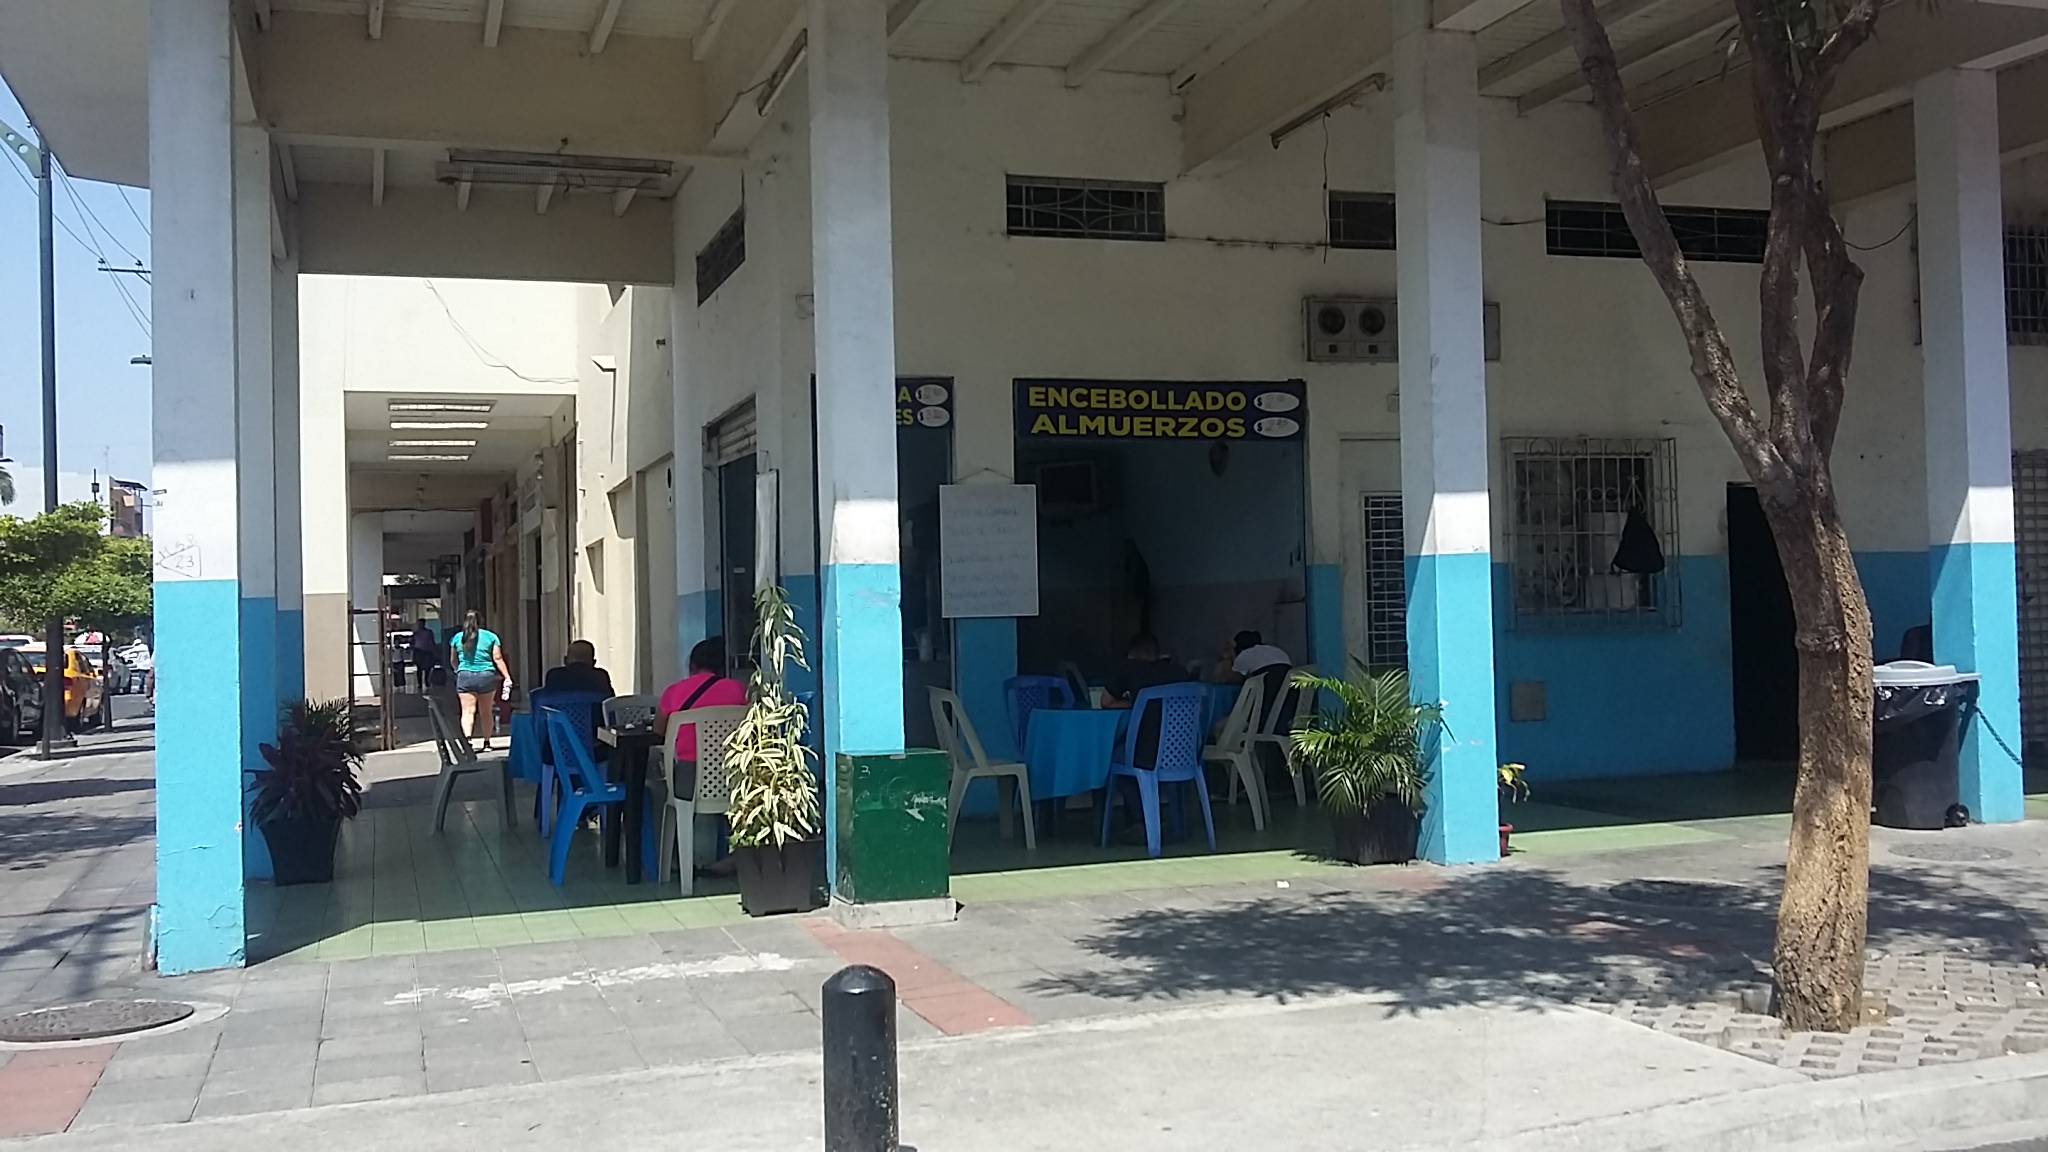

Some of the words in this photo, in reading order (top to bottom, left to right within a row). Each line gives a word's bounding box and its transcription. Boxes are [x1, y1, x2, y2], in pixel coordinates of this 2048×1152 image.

[1028, 386, 1247, 412] ENCEBOLLADO
[1030, 414, 1246, 438] ALMUERZOS
[175, 554, 195, 569] 23
